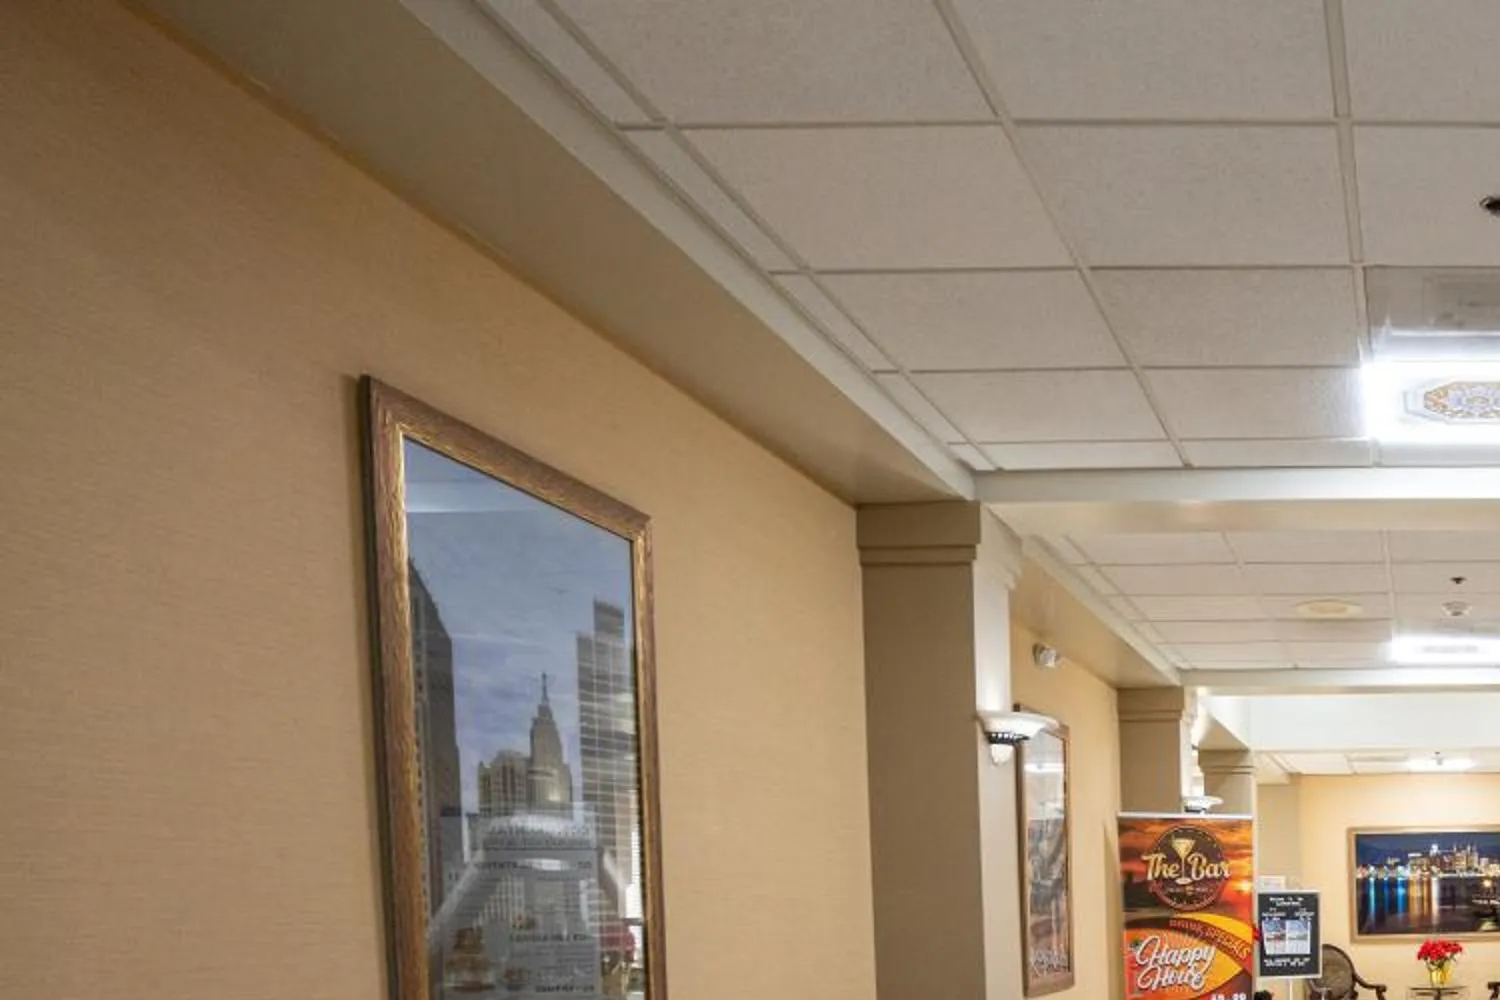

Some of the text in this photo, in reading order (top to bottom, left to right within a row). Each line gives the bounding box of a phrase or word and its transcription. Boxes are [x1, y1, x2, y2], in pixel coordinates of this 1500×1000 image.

[1141, 851, 1231, 881] The Bar
[1136, 935, 1217, 983] Happy
[1137, 965, 1205, 991] Hour
